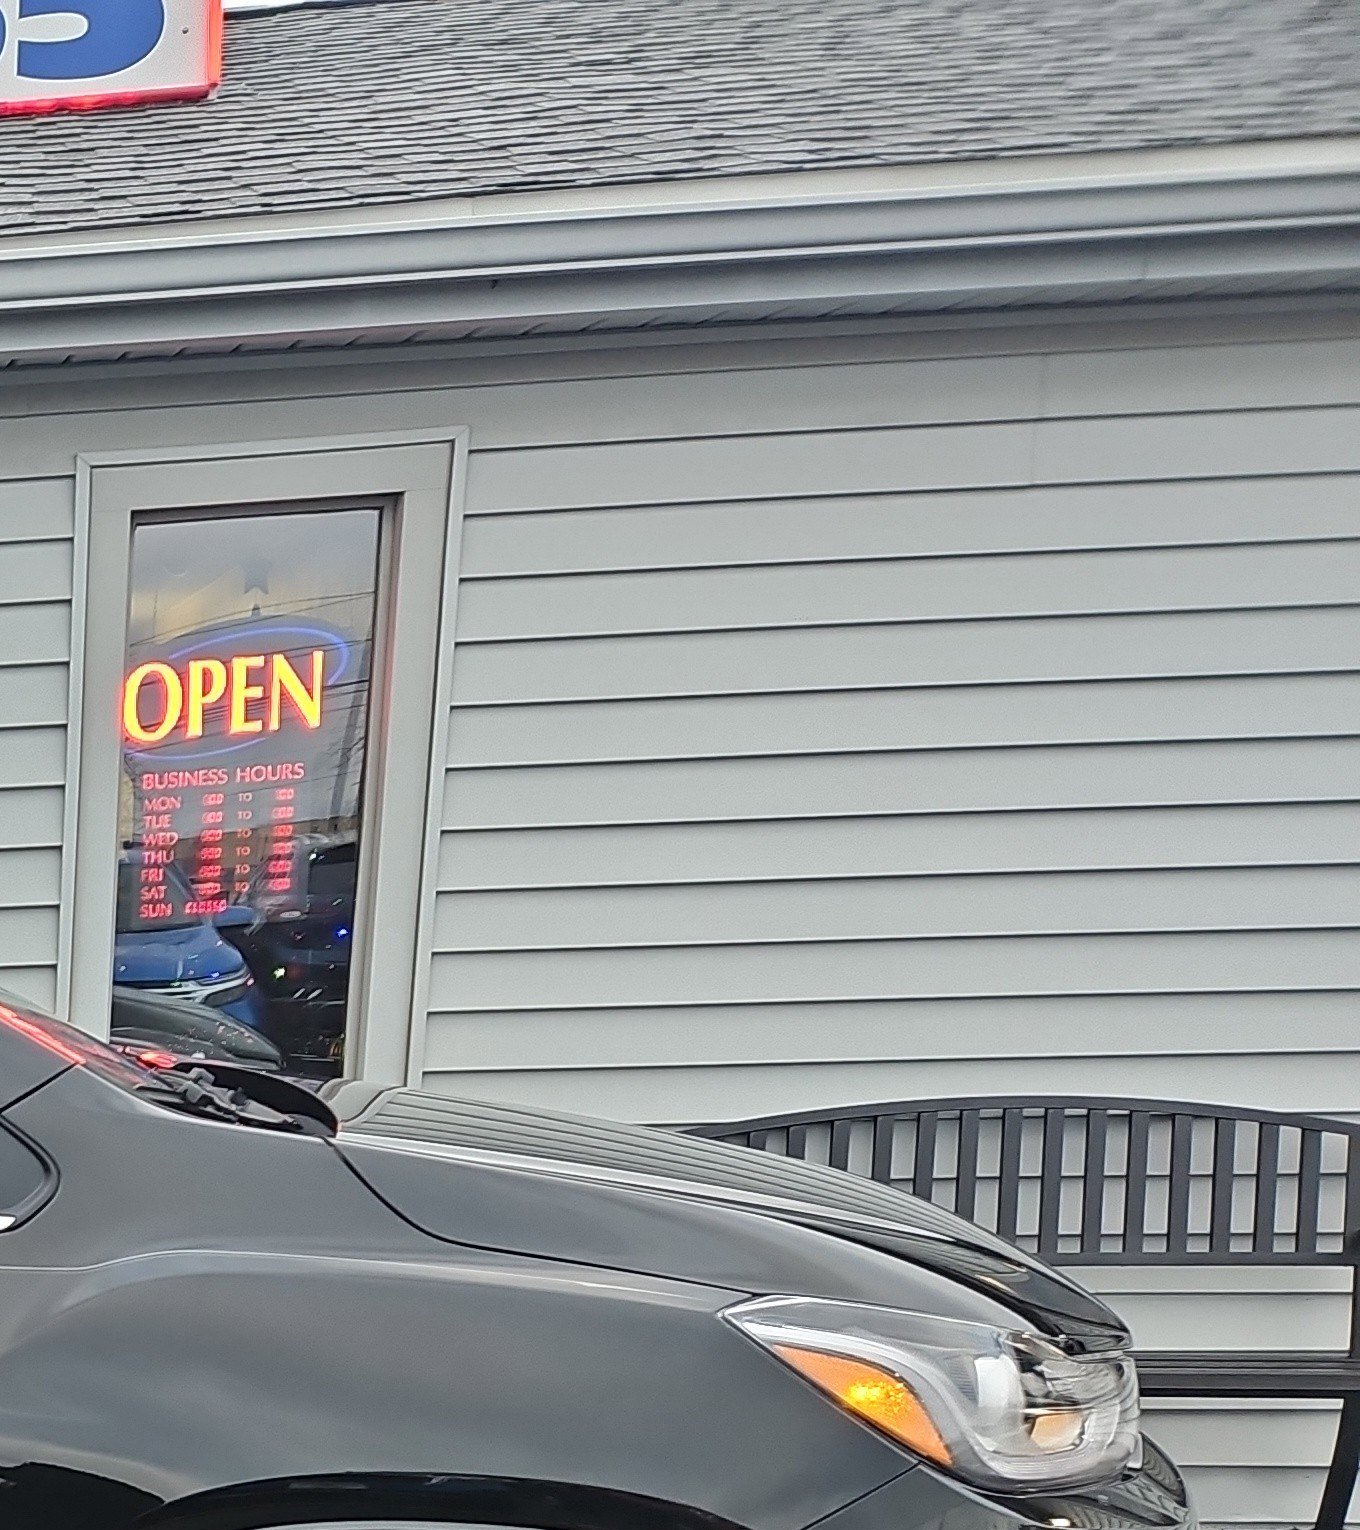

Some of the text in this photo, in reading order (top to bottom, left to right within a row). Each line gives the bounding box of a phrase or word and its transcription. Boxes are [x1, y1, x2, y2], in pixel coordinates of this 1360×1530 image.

[122, 650, 325, 742] OPEN
[142, 762, 305, 790] BUSINESS HOURS
[143, 796, 181, 812] MON
[237, 792, 253, 802] TO
[142, 814, 173, 829] TUE
[142, 832, 179, 847] WED
[142, 850, 175, 864] THU
[140, 868, 164, 882] FRI
[139, 885, 167, 900] SAT
[139, 903, 173, 918] SUN
